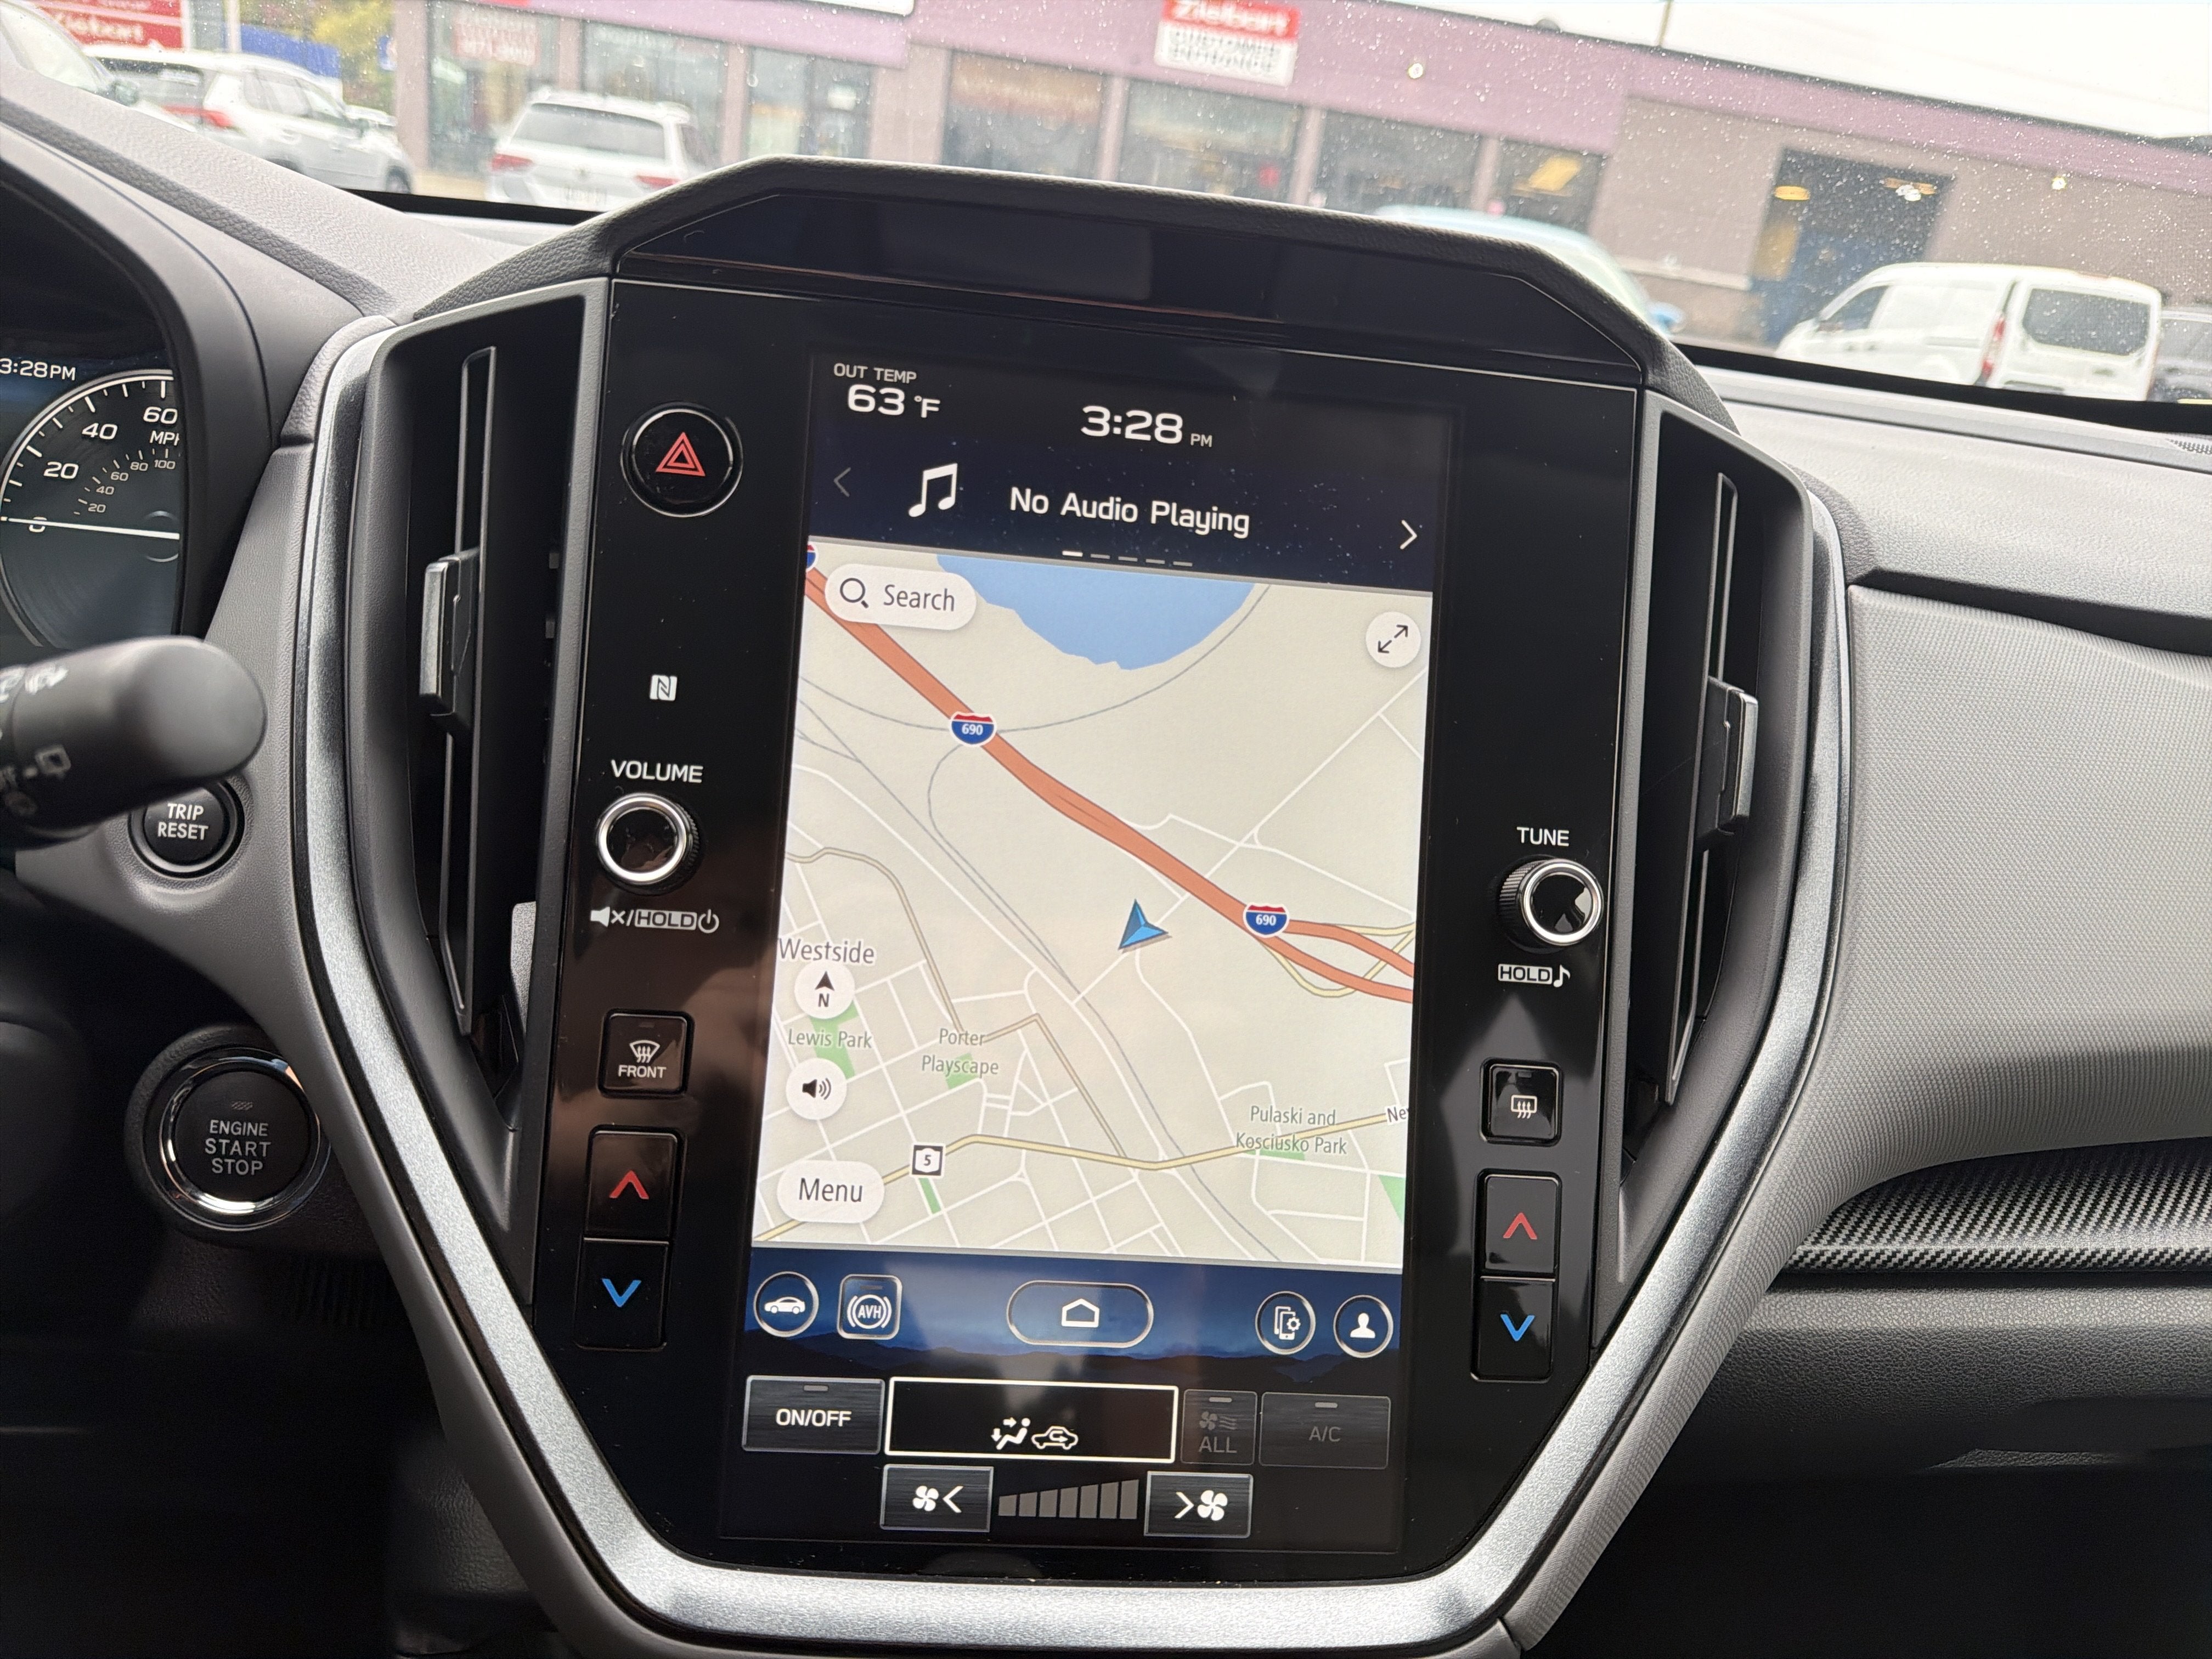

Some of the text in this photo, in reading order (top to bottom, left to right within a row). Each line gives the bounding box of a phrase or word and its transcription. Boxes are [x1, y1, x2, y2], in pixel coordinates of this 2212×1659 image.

[834, 363, 917, 384] OUT TEMP
[847, 383, 905, 416] 63
[143, 406, 178, 425] 60
[82, 422, 118, 439] 40
[1081, 405, 1213, 448] 3:28 PM
[44, 461, 78, 479] 20
[130, 461, 149, 472] 80
[154, 459, 176, 470] 100
[110, 471, 128, 482] 60
[96, 486, 115, 495] 40
[88, 503, 106, 513] 20
[1010, 487, 1250, 539] No Audio Playing
[883, 584, 955, 612] Search
[961, 723, 984, 736] 690
[611, 759, 704, 783] VOLUME
[167, 803, 204, 821] TRIP
[157, 821, 208, 841] RESET
[1517, 826, 1570, 847] TUNE
[1255, 912, 1277, 927] 690
[778, 938, 875, 964] Westside
[1500, 965, 1551, 982] HOLD
[818, 993, 830, 1008] N
[788, 1029, 872, 1048] Lewis Park
[939, 1028, 986, 1046] Porter
[618, 1064, 667, 1079] FRONT
[922, 1055, 999, 1079] Playscape
[1251, 1105, 1336, 1126] Pulaski and
[209, 1120, 269, 1137] ENGINE
[205, 1138, 270, 1158] START
[1235, 1132, 1347, 1154] Kosciusko Park
[212, 1158, 264, 1176] STOP
[923, 1154, 932, 1166] 5
[799, 1177, 863, 1203] Menu
[857, 1305, 882, 1319] AVH
[775, 1407, 851, 1427] ON/OFF
[1308, 1425, 1341, 1443] A/C
[1198, 1435, 1238, 1455] ALL
